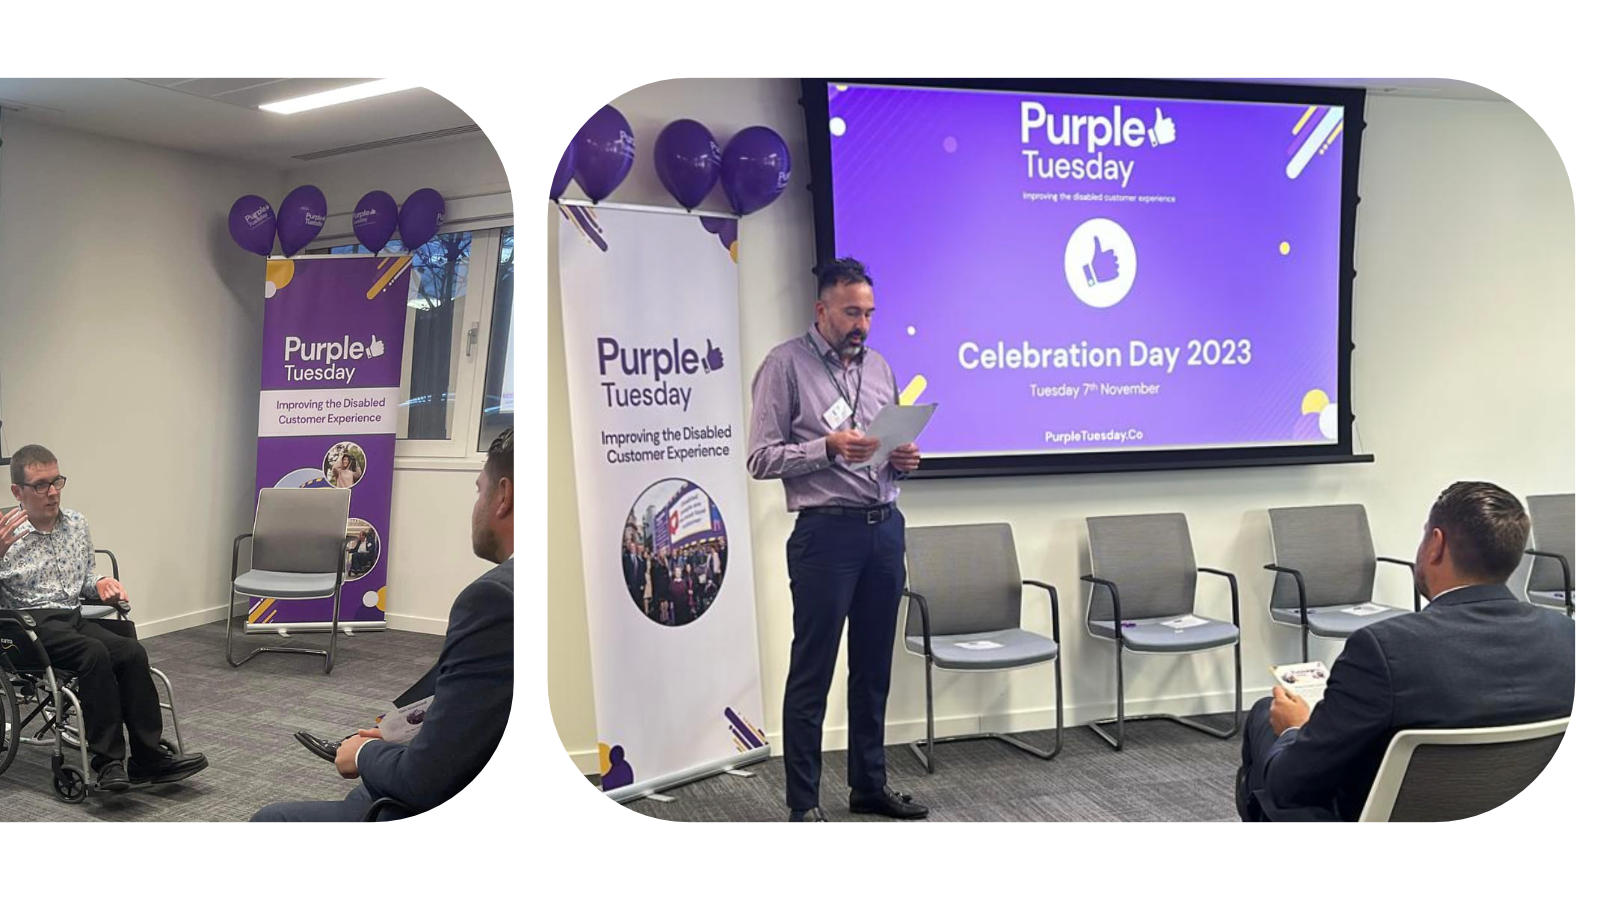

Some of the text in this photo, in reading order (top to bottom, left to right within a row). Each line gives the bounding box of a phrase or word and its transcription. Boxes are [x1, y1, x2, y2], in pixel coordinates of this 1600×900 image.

[1021, 101, 1146, 153] Purple
[1021, 150, 1135, 188] Tuesday
[1022, 192, 1176, 203] Improving the disabled customer experience
[284, 335, 365, 365] Purple
[597, 337, 699, 382] Purple
[958, 339, 1252, 374] Celebration Day 2023
[284, 363, 356, 385] Tuesday
[600, 380, 692, 412] Tuesday
[1030, 382, 1160, 399] Tuesday 7th November
[276, 397, 386, 411] Improving the Disabled
[278, 412, 382, 425] Customer Experience
[601, 424, 732, 448] Improving the Disabled
[1045, 429, 1144, 444] PurpleTuesday.Co
[606, 444, 730, 464] Customer Experience
